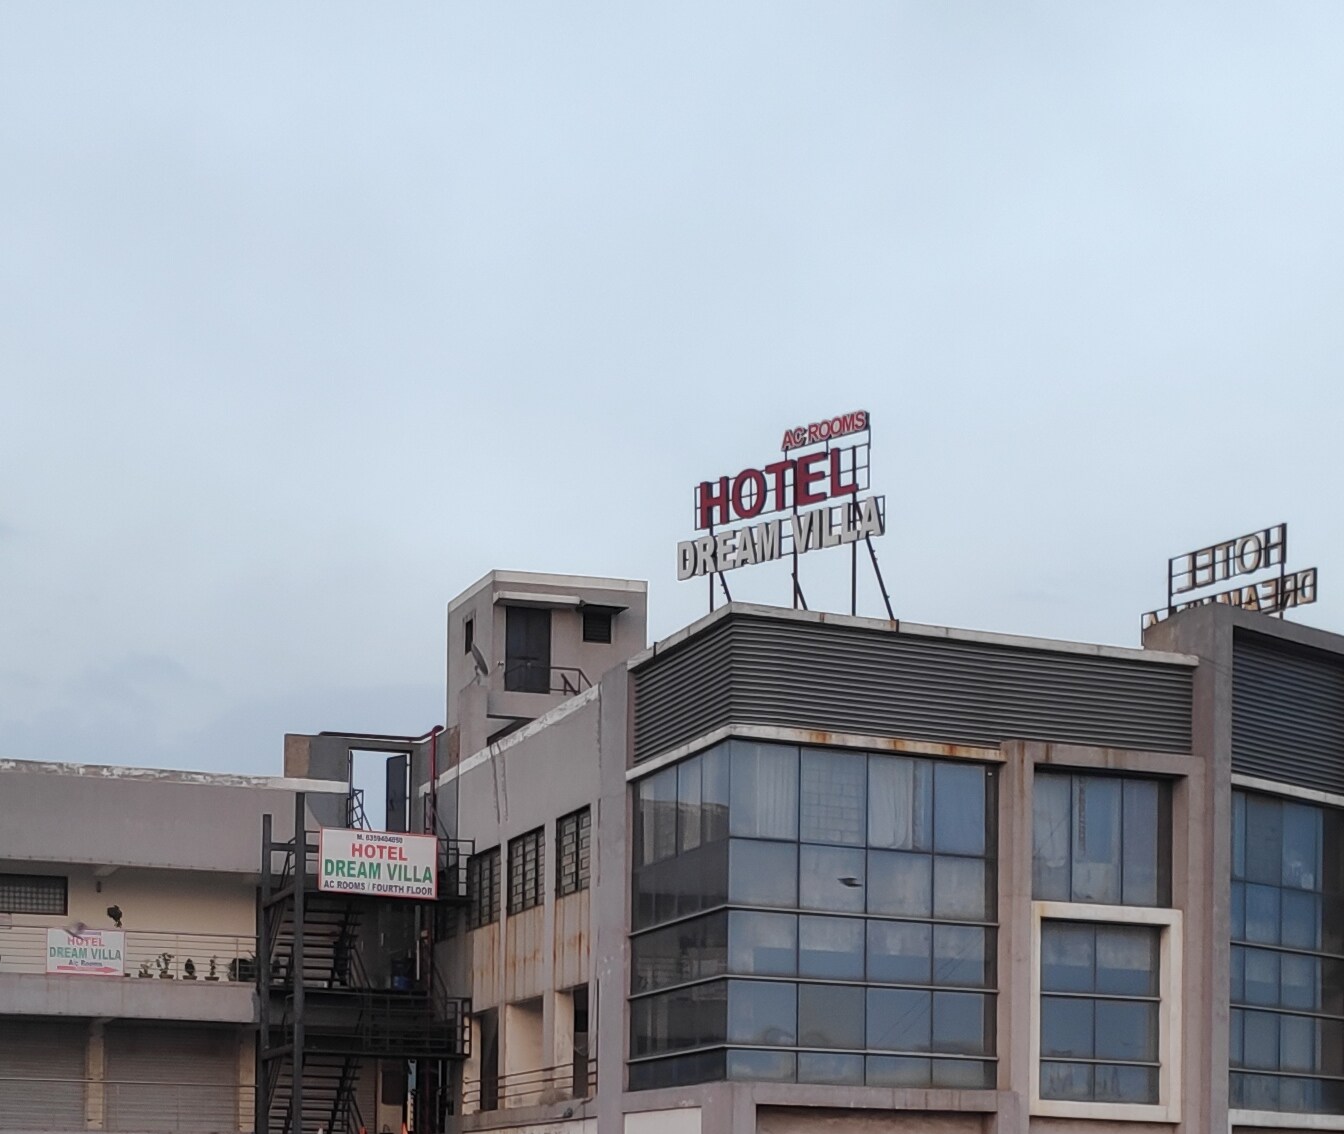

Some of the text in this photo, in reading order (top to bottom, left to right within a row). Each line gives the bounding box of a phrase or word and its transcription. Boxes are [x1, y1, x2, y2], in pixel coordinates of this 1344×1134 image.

[781, 409, 869, 452] AC ROOMS
[699, 447, 859, 530] HOTEL
[677, 496, 885, 581] DREAM VILLA
[351, 843, 408, 861] HOTEL
[324, 858, 433, 884] DREAM VILLA
[324, 880, 334, 889] AC
[337, 881, 366, 891] ROOMS
[372, 883, 404, 893] FOURTH
[406, 887, 433, 896] FLOOR
[68, 936, 105, 947] HOTEL
[50, 947, 122, 960] DREAM VILLA
